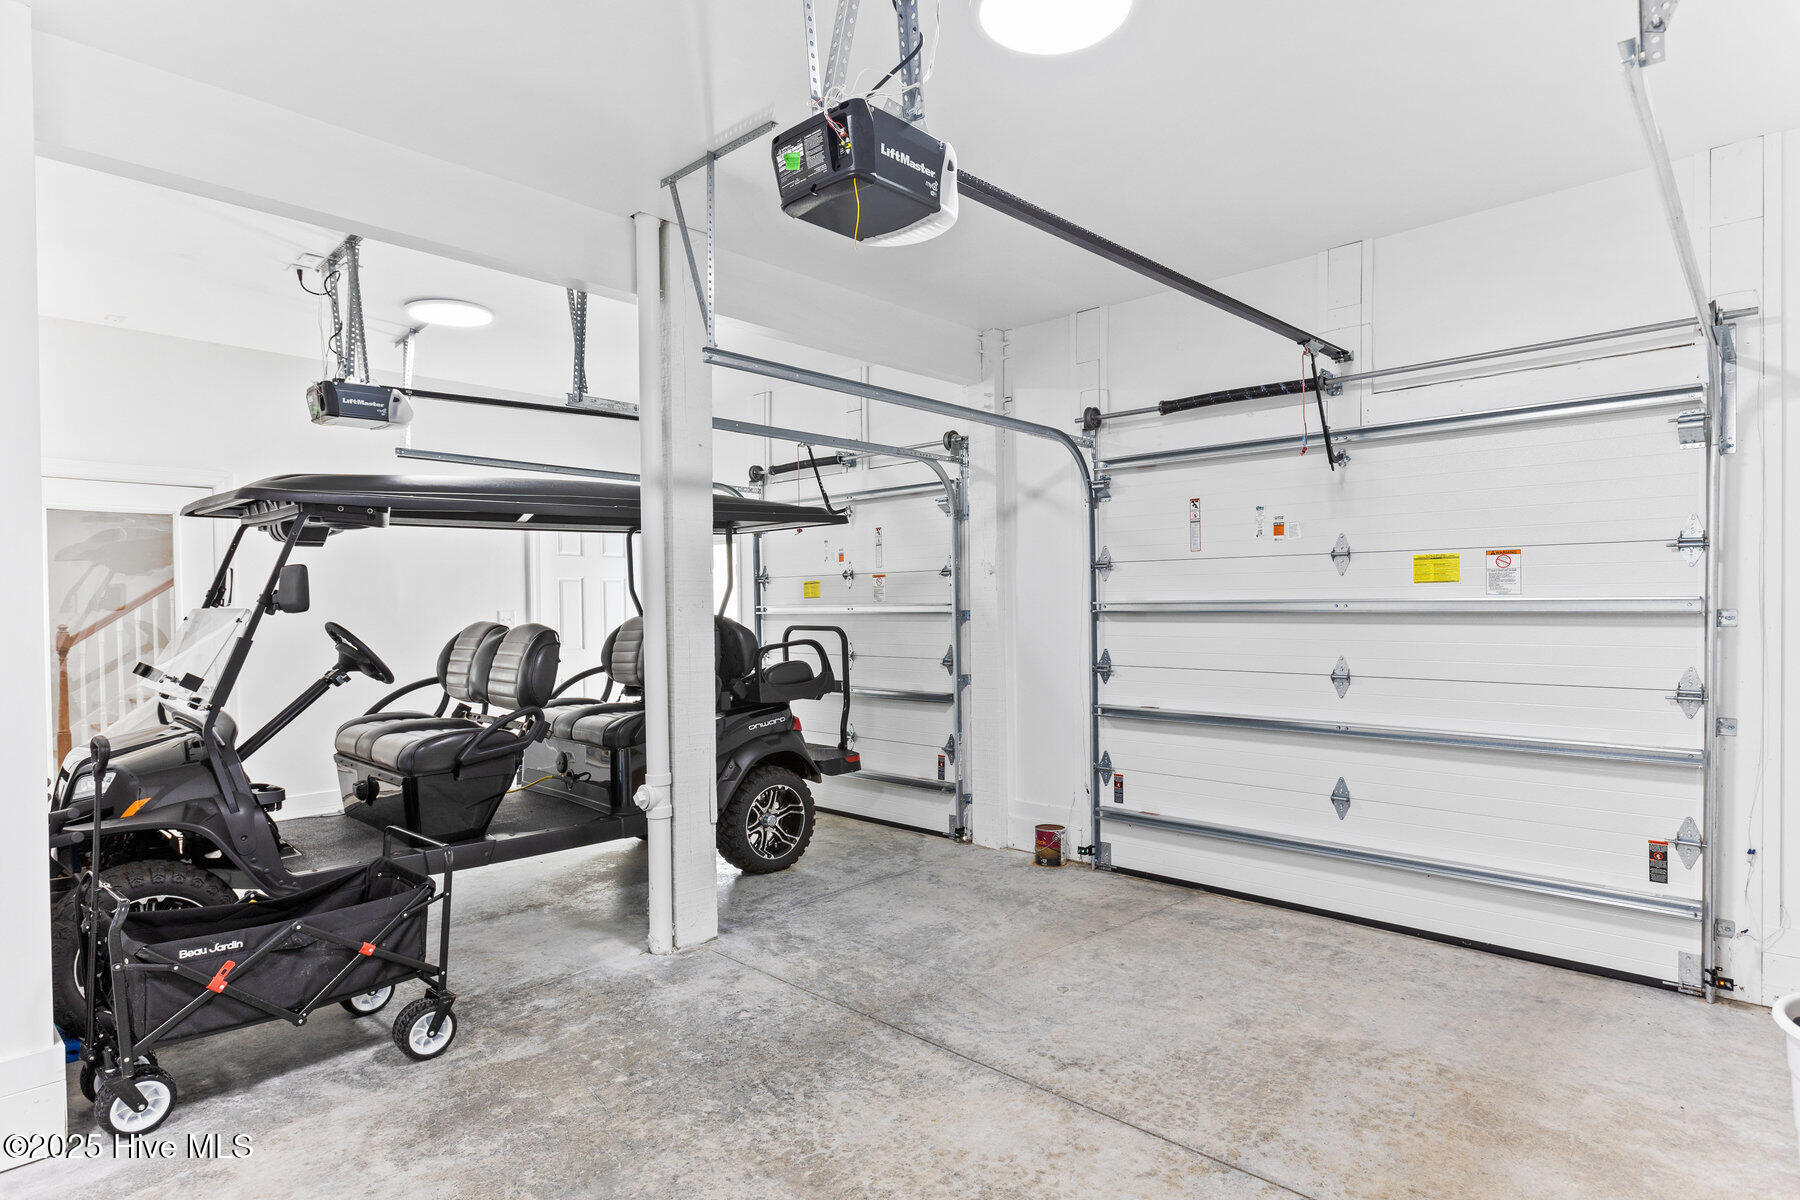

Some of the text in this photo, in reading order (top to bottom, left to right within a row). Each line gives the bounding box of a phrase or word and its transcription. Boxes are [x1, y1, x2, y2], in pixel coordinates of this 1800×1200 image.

[880, 142, 936, 178] LiftMaster
[342, 397, 385, 408] LiftMaster
[178, 940, 244, 960] Beau Jardin
